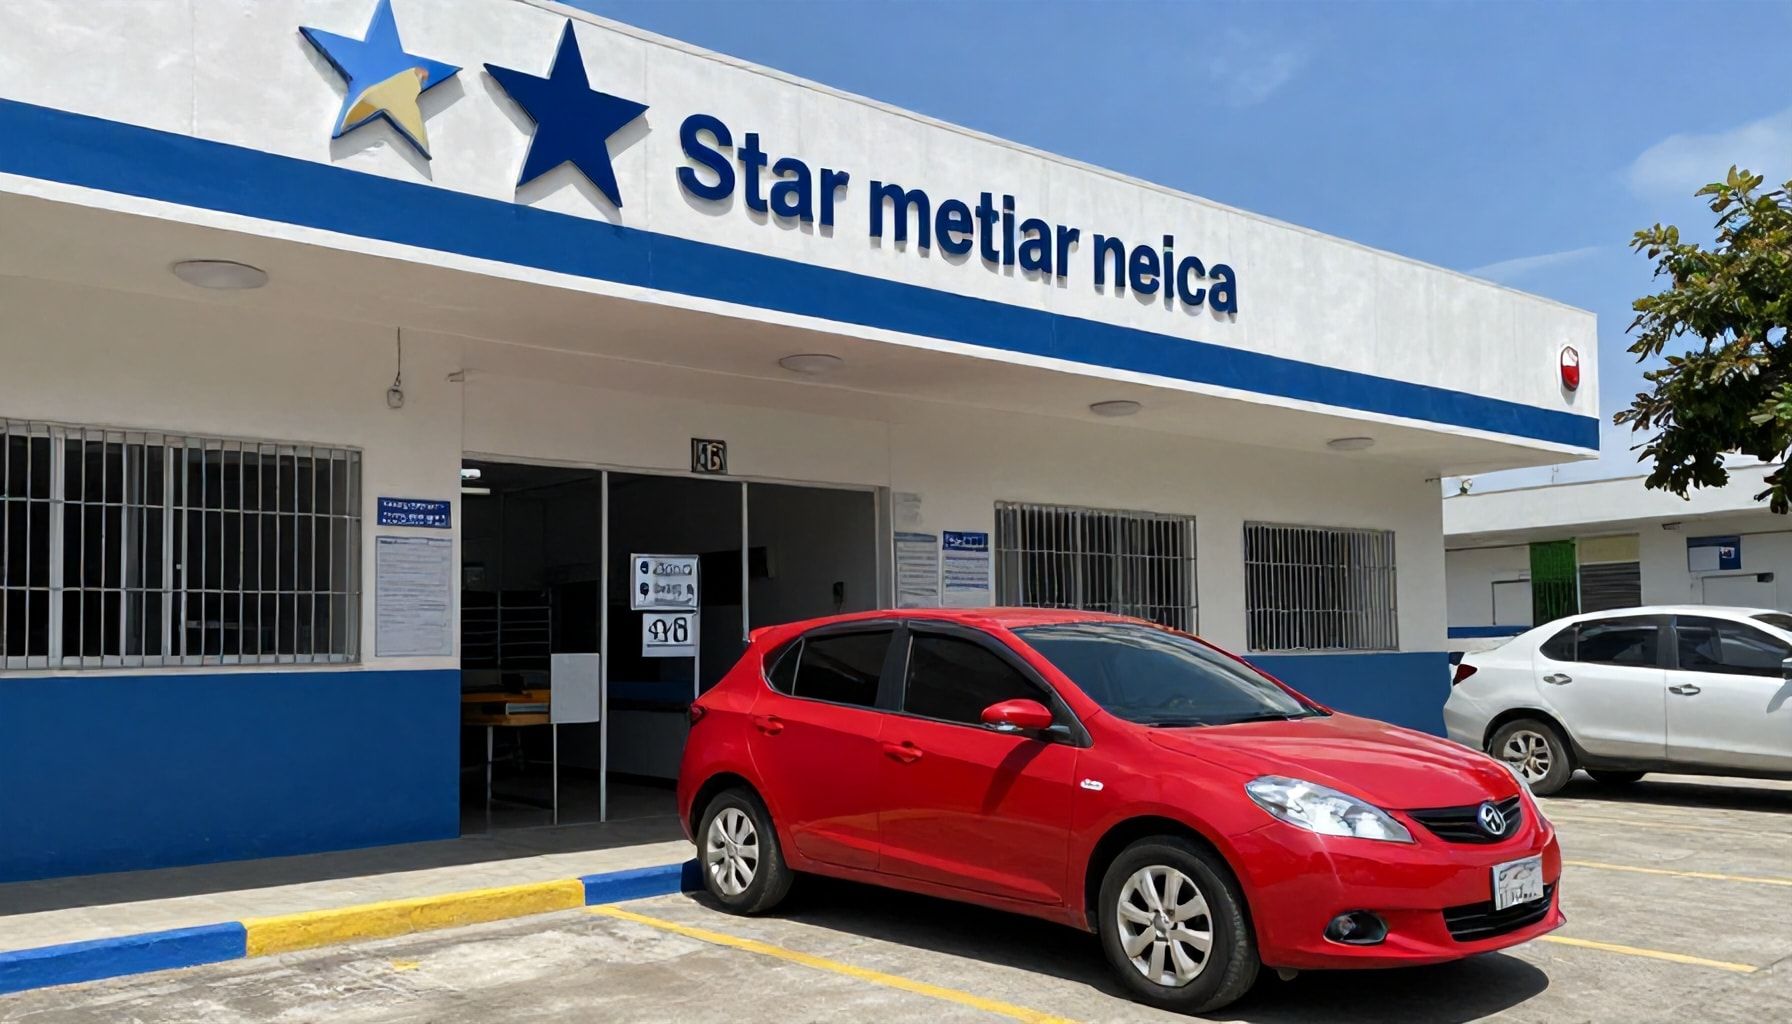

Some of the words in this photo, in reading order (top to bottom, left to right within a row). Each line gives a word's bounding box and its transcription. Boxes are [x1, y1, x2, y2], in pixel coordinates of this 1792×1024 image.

[676, 113, 850, 227] Star
[870, 180, 1080, 277] metiar
[1093, 234, 1239, 314] neica
